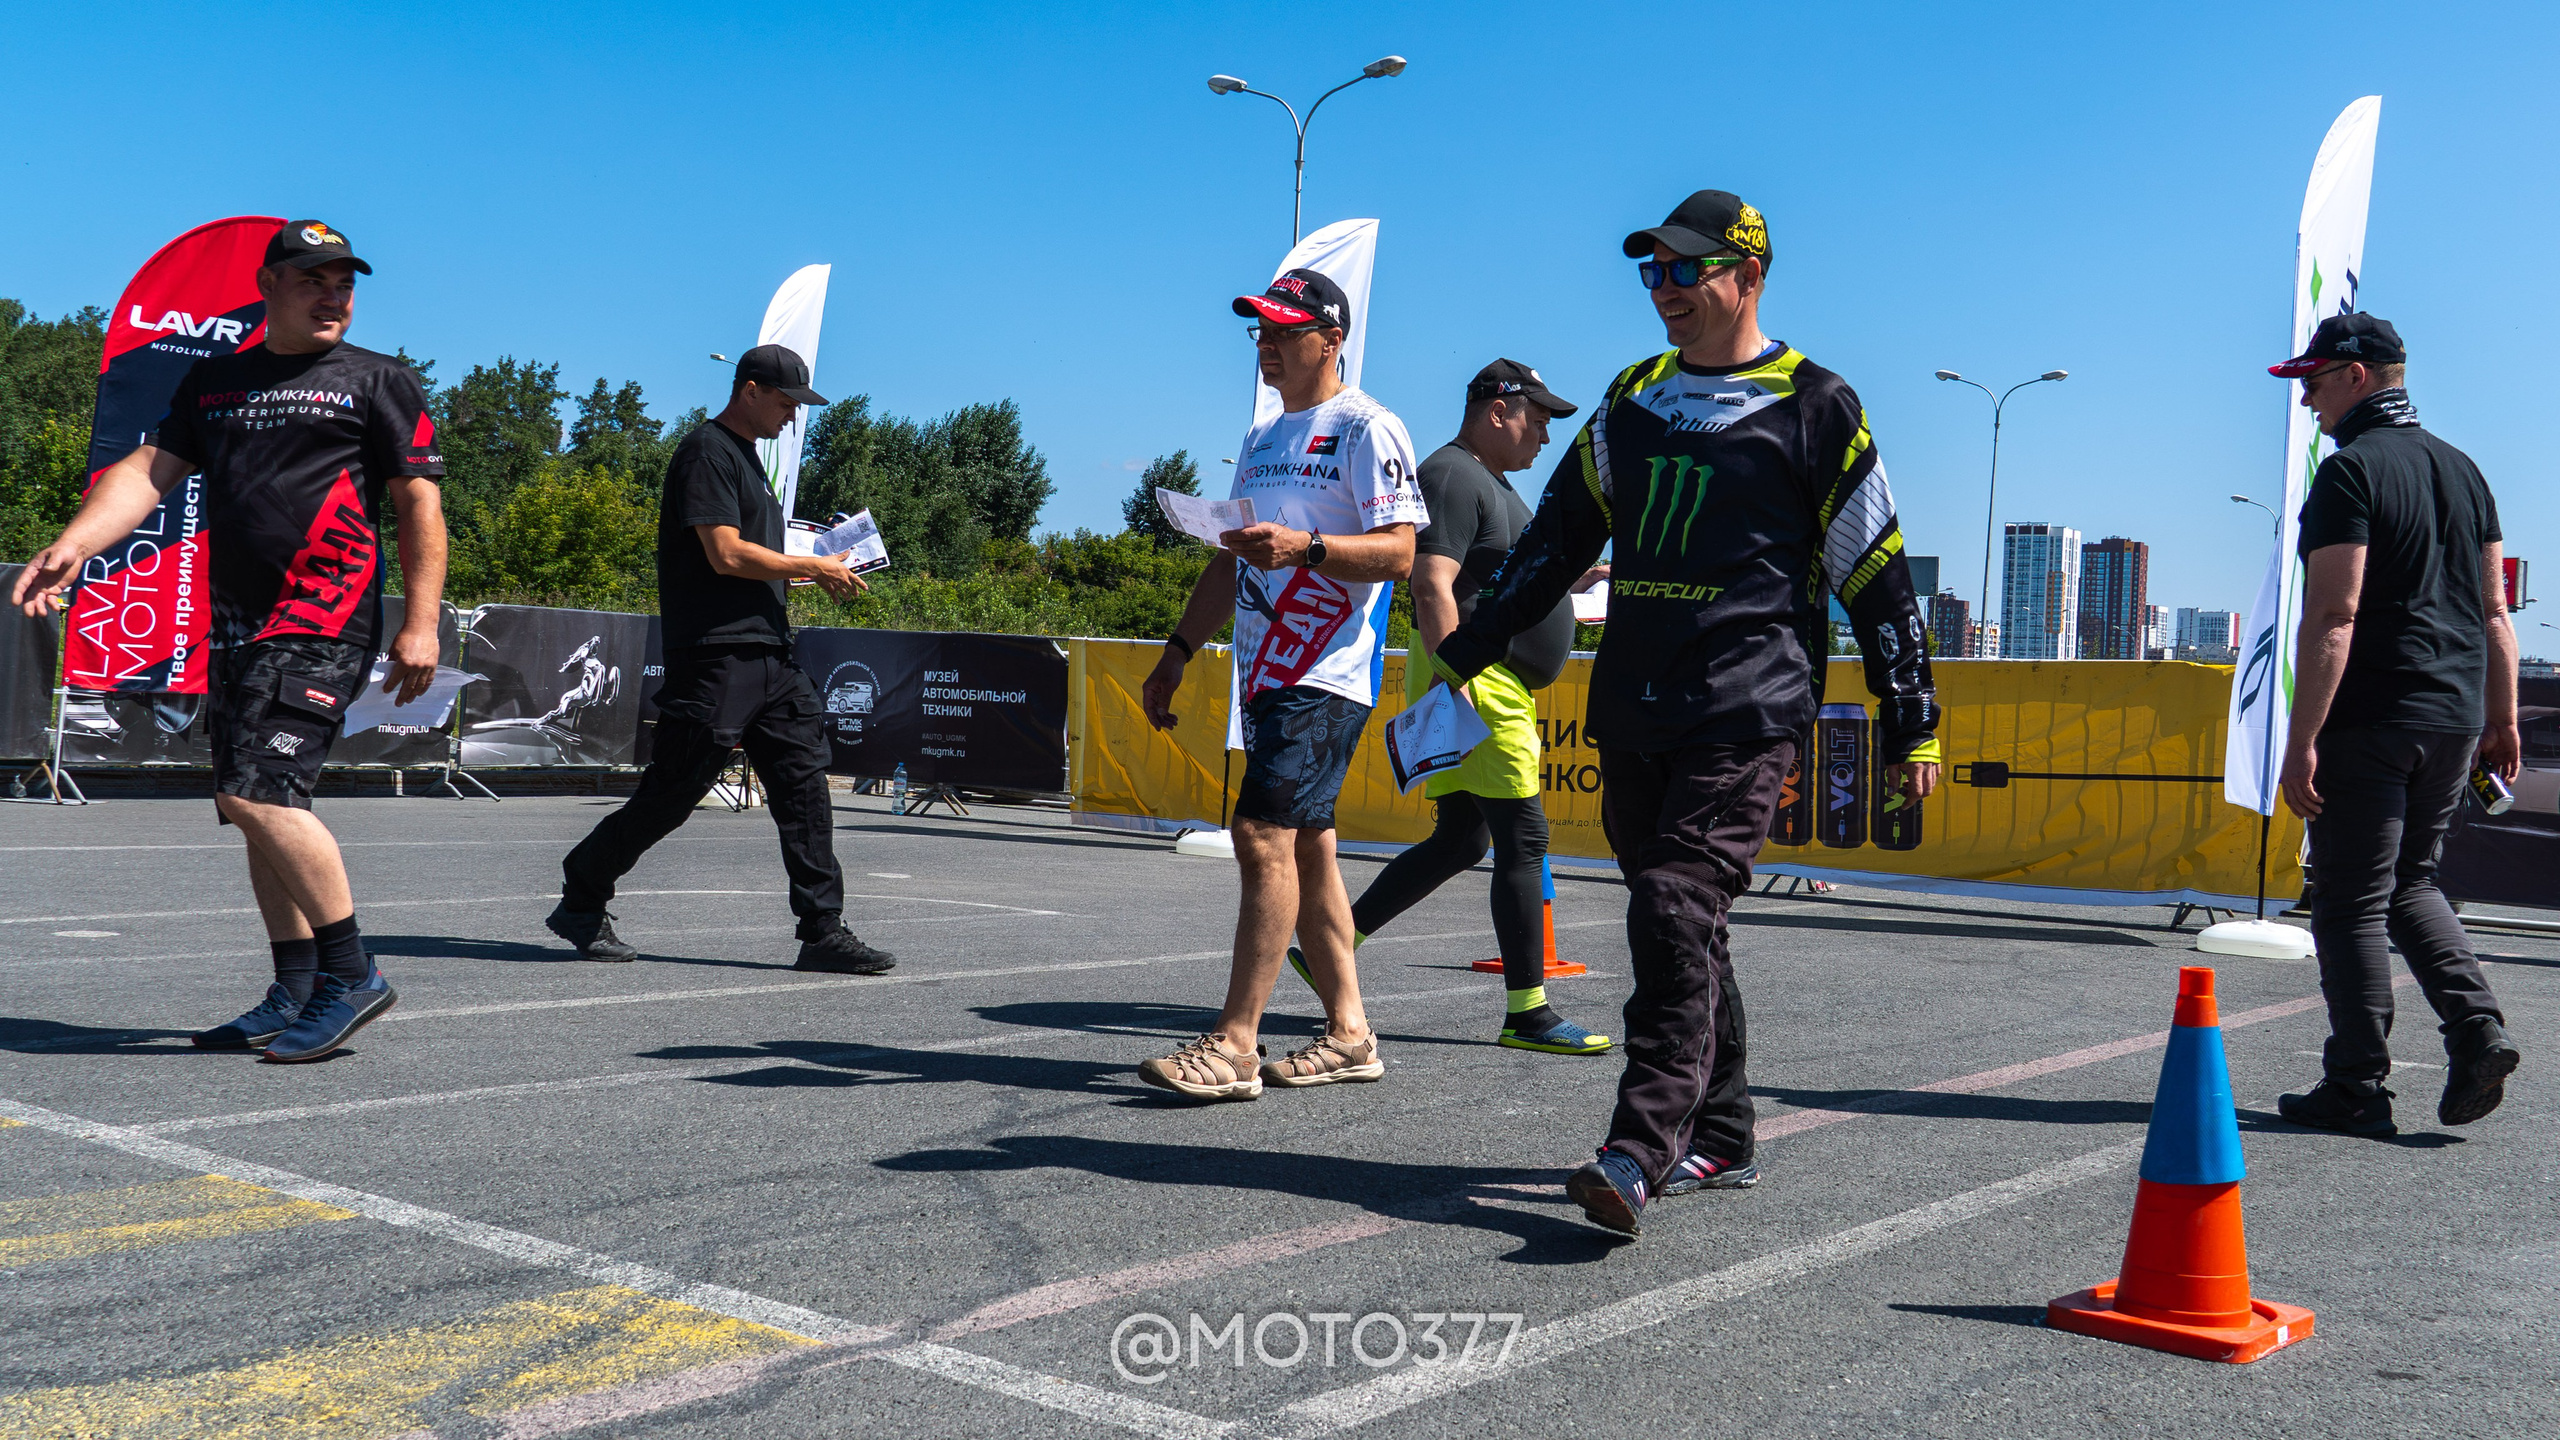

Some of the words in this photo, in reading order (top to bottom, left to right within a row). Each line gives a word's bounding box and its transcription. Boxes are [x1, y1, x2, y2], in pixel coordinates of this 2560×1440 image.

[150, 342, 212, 358] MOTOLINE
[200, 389, 354, 409] MOTOGYMKHANA
[207, 406, 335, 420] EKATERINBURG
[246, 418, 286, 430] TEAM
[1294, 481, 1327, 490] TEAM
[270, 503, 375, 633] TEAM
[1633, 581, 1725, 601] CIRCUIT
[72, 556, 120, 678] LAVR
[1252, 571, 1347, 693] TEAM
[167, 633, 189, 686] Твое
[923, 669, 959, 683] МУЗЕЙ
[922, 687, 1026, 704] АВТОМОБИЛЬНОЙ
[922, 704, 972, 717] ТЕХНИКИ
[921, 733, 967, 743] #AUTO_UGMK
[921, 746, 966, 758] mkugmk.ru
[1576, 820, 1589, 828] до
